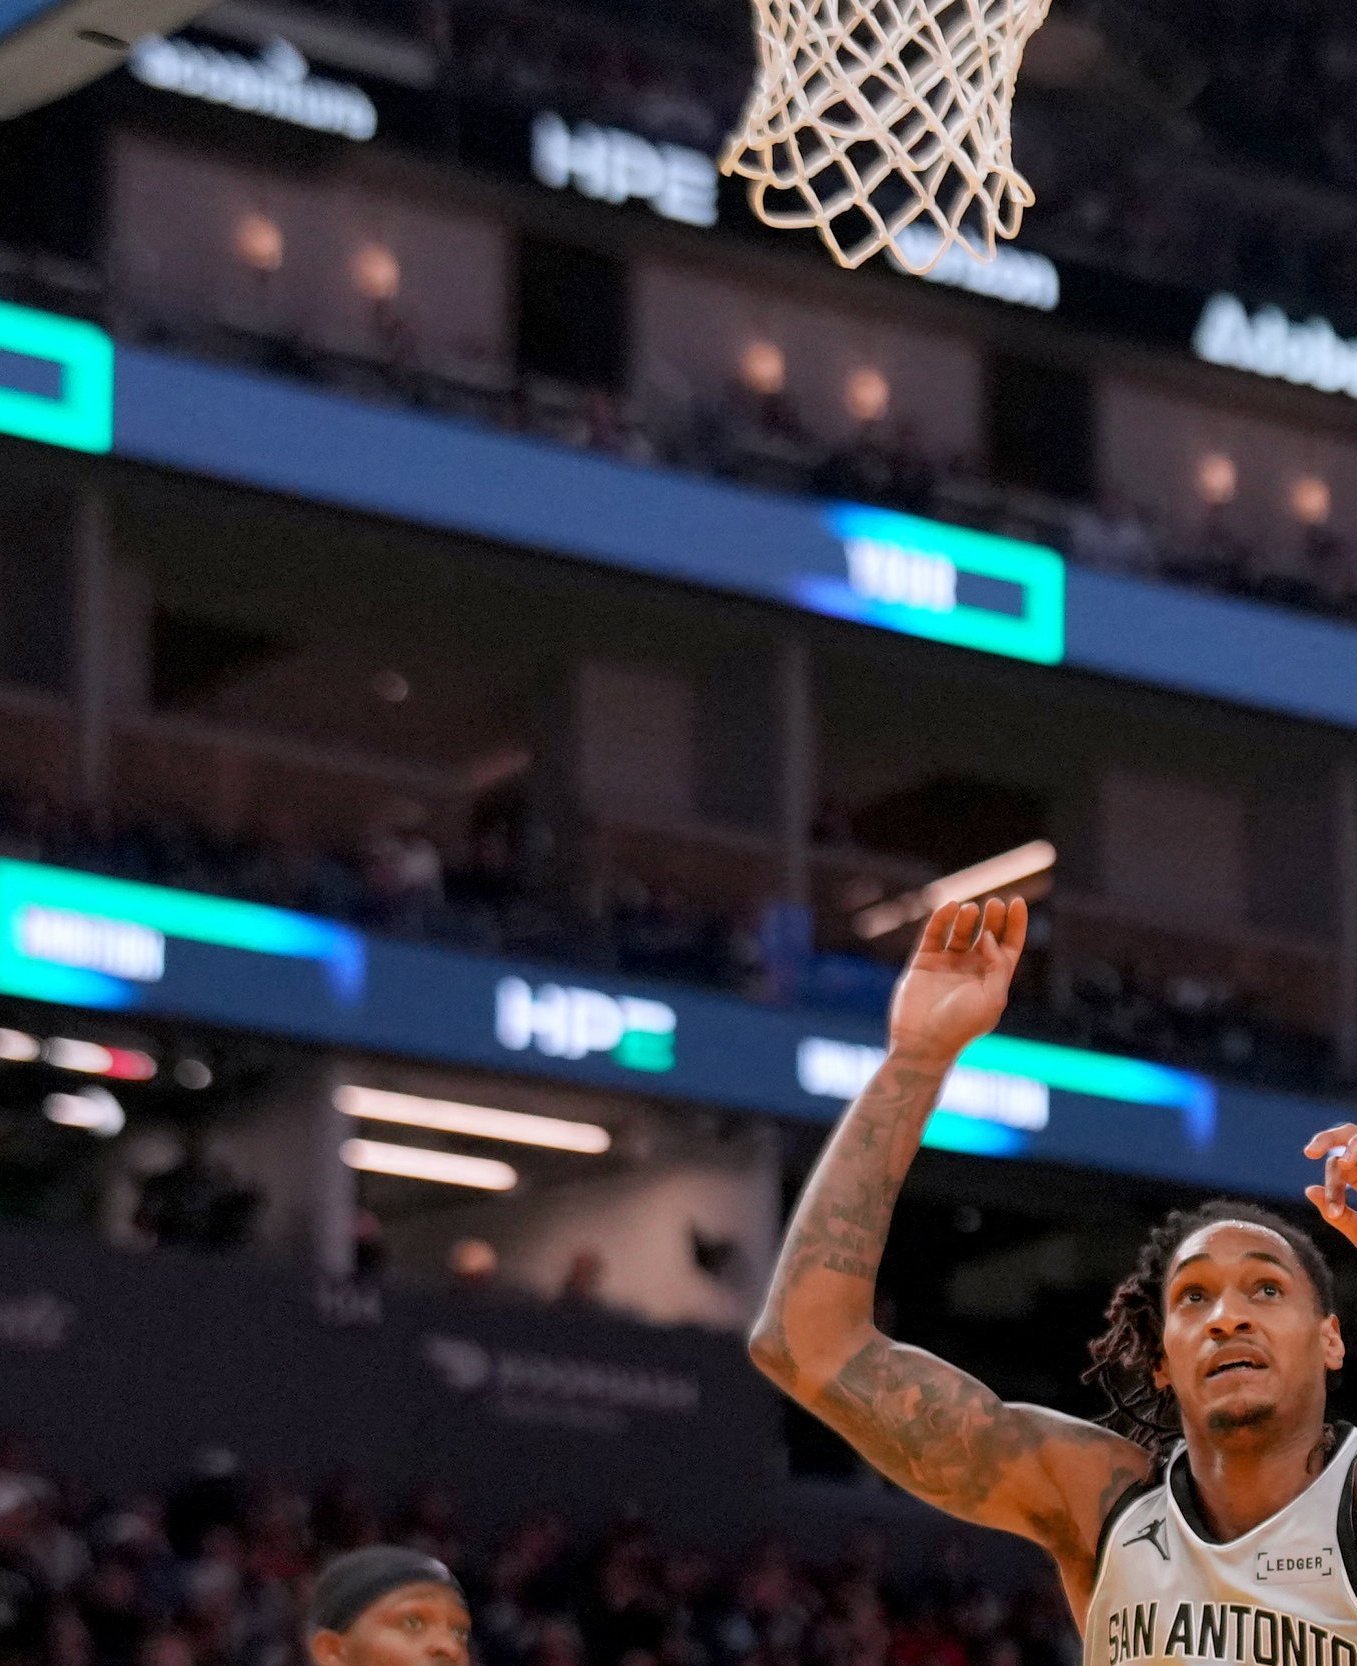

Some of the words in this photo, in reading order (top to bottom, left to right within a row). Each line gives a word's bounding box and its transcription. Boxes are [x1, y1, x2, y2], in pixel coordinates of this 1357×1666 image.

[530, 110, 720, 227] HPE
[495, 975, 677, 1073] HPE
[1266, 1556, 1323, 1572] LEDGER
